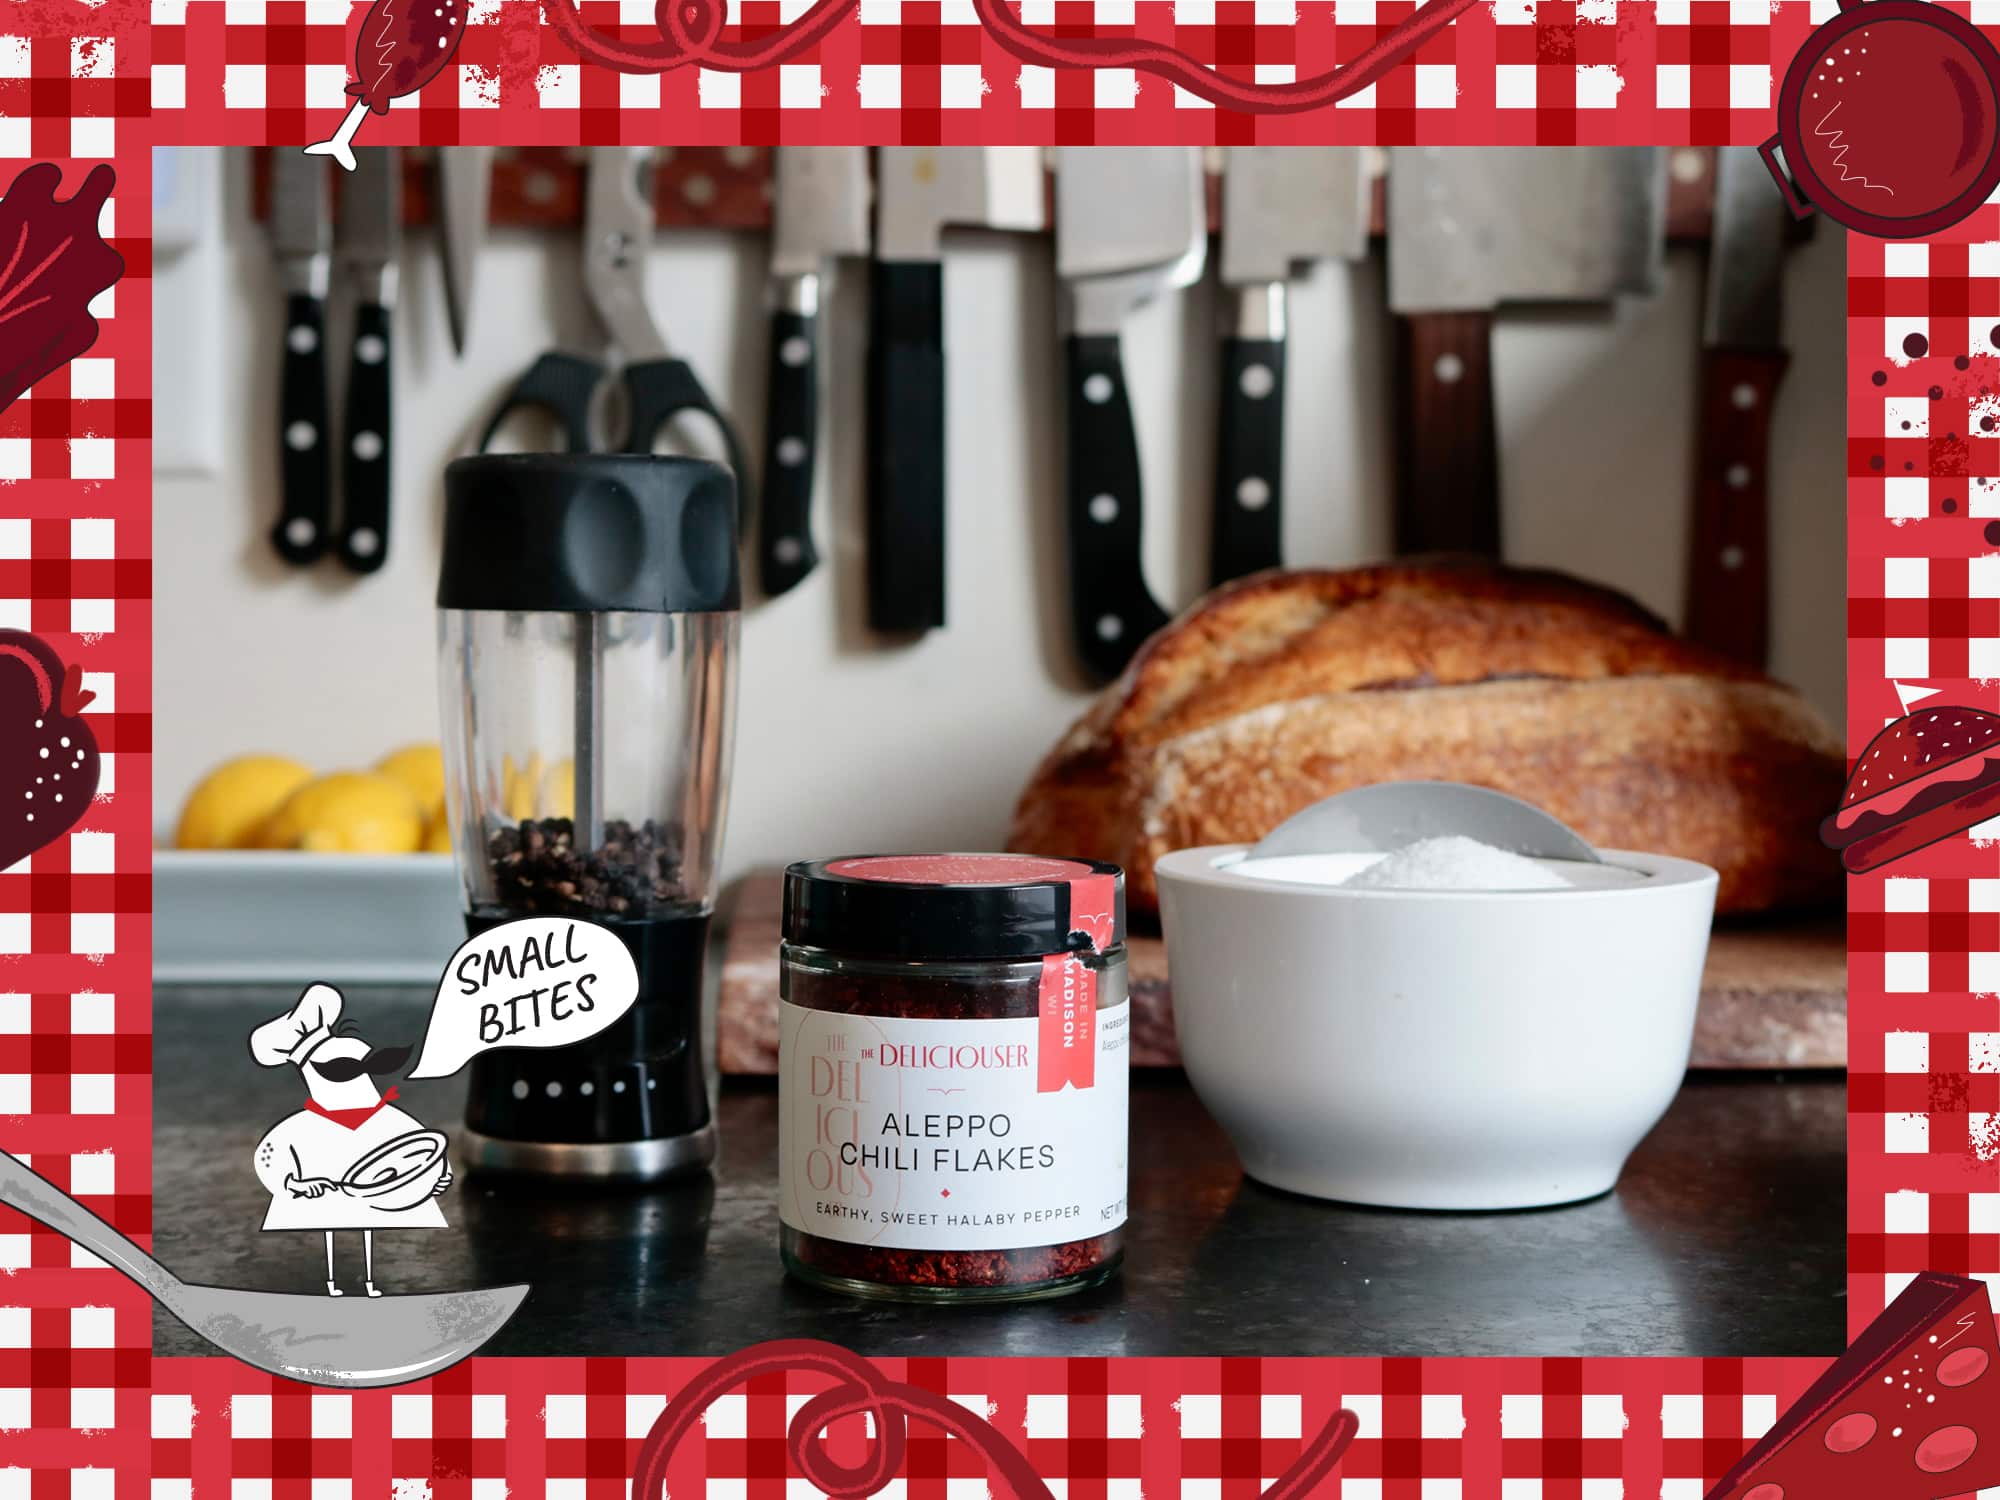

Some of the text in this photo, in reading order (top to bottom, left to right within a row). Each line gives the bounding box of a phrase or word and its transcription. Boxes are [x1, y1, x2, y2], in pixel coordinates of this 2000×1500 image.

[1047, 995, 1057, 1015] WI
[1063, 959, 1074, 1048] MADISON
[1079, 970, 1088, 1039] MADE IN
[860, 1043, 1029, 1069] THE DELICIOUSER
[880, 1112, 1012, 1138] ALEPPO
[840, 1142, 1055, 1172] CHILI FLAKES
[816, 1202, 1081, 1226] EARTHY, SWEET HALABY PEPPER
